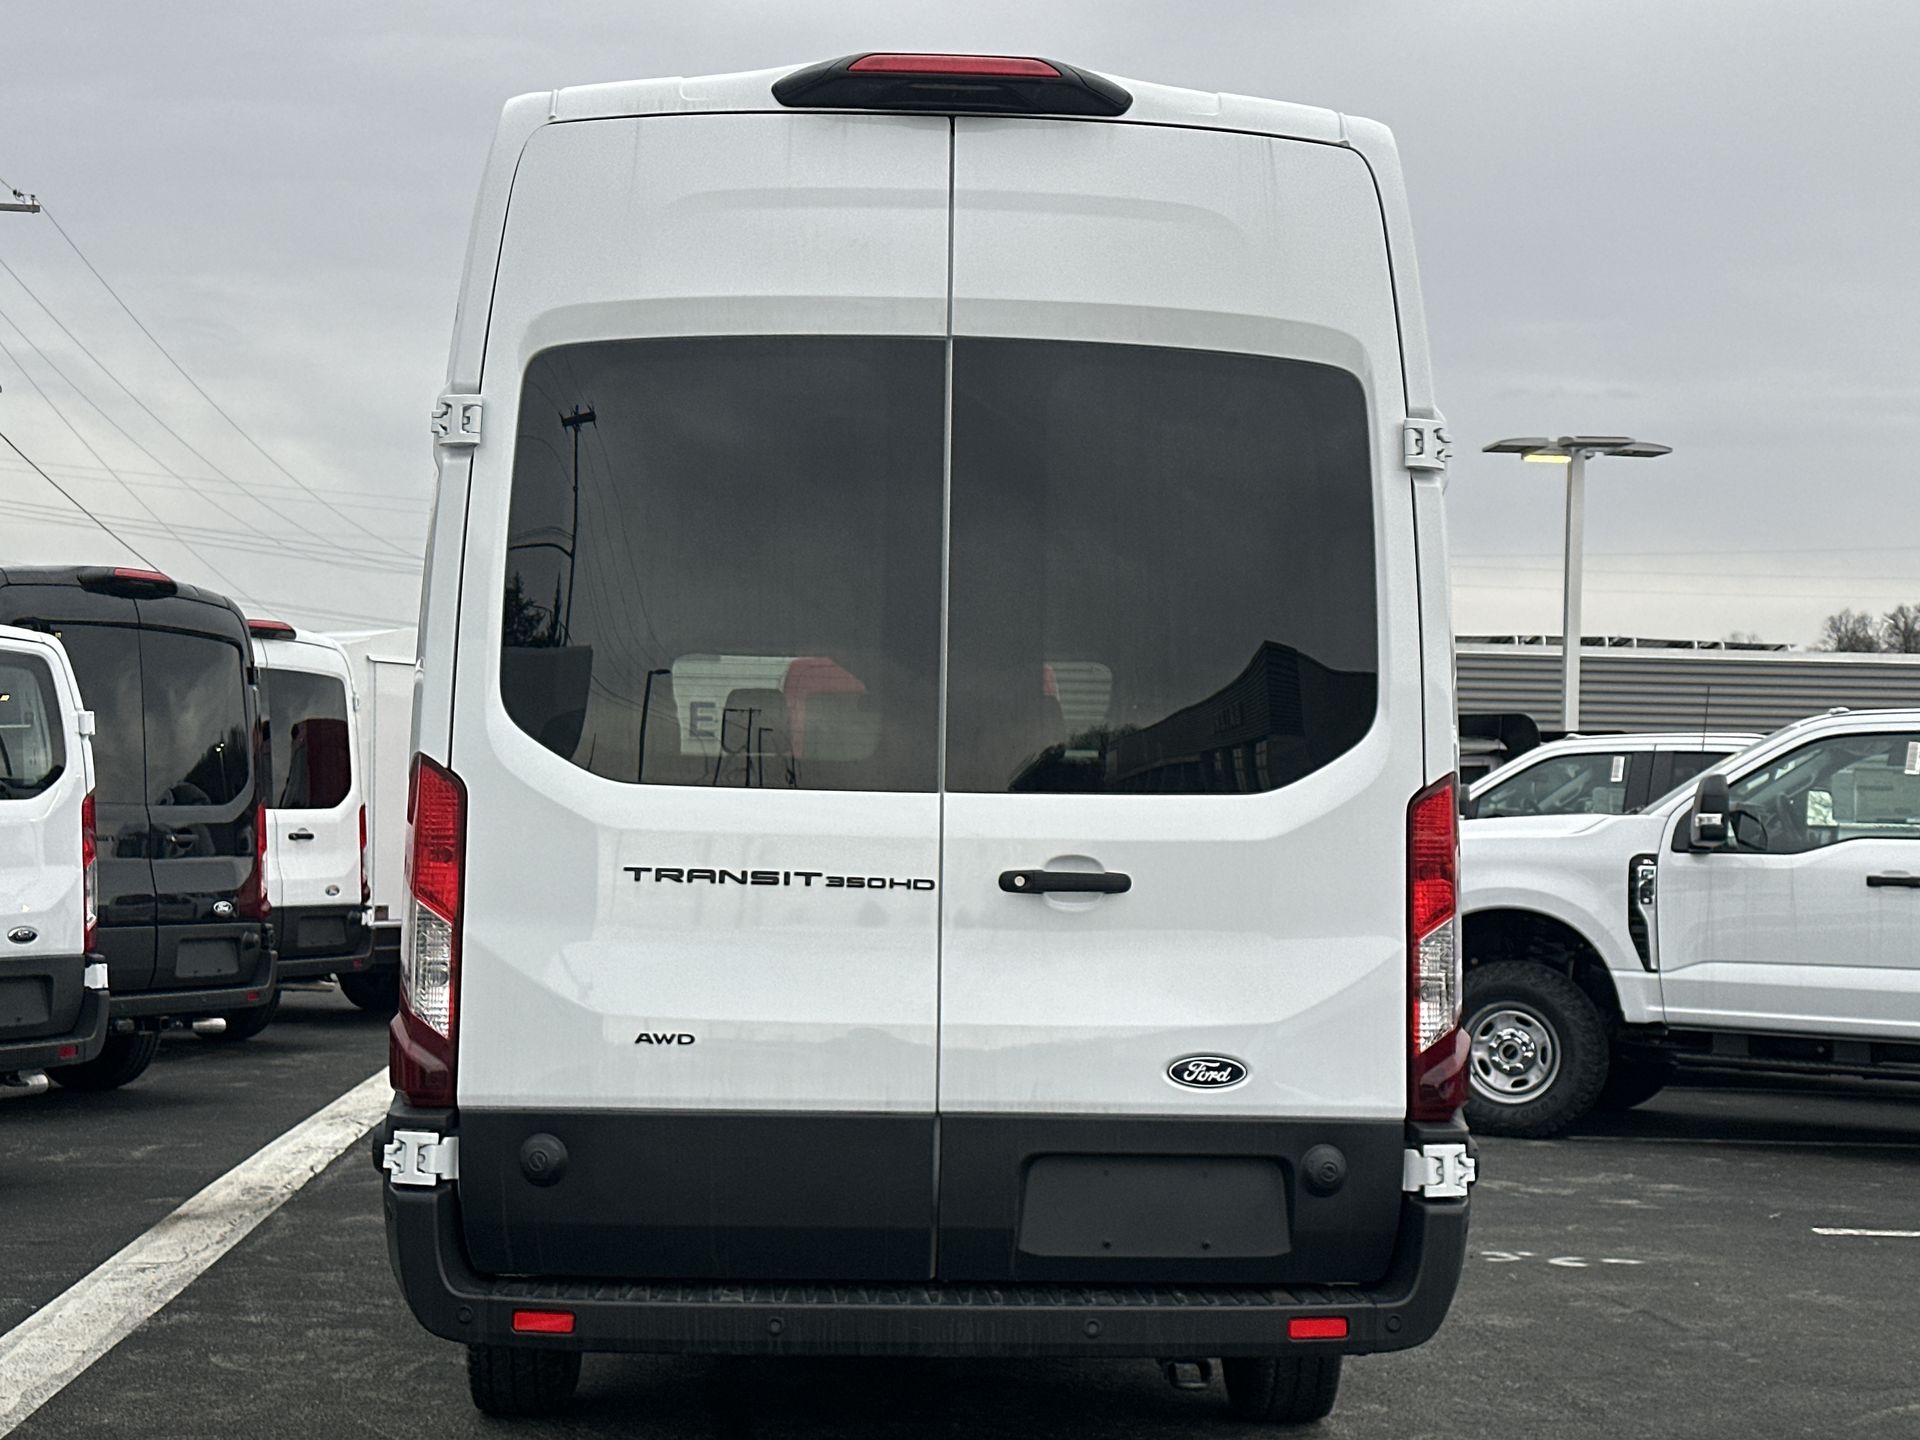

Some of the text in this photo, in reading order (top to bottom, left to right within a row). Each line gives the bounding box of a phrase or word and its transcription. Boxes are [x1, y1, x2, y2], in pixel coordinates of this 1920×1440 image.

[623, 867, 823, 887] TRANSIT
[634, 1033, 696, 1046] AWD
[1182, 1060, 1233, 1083] Ford
